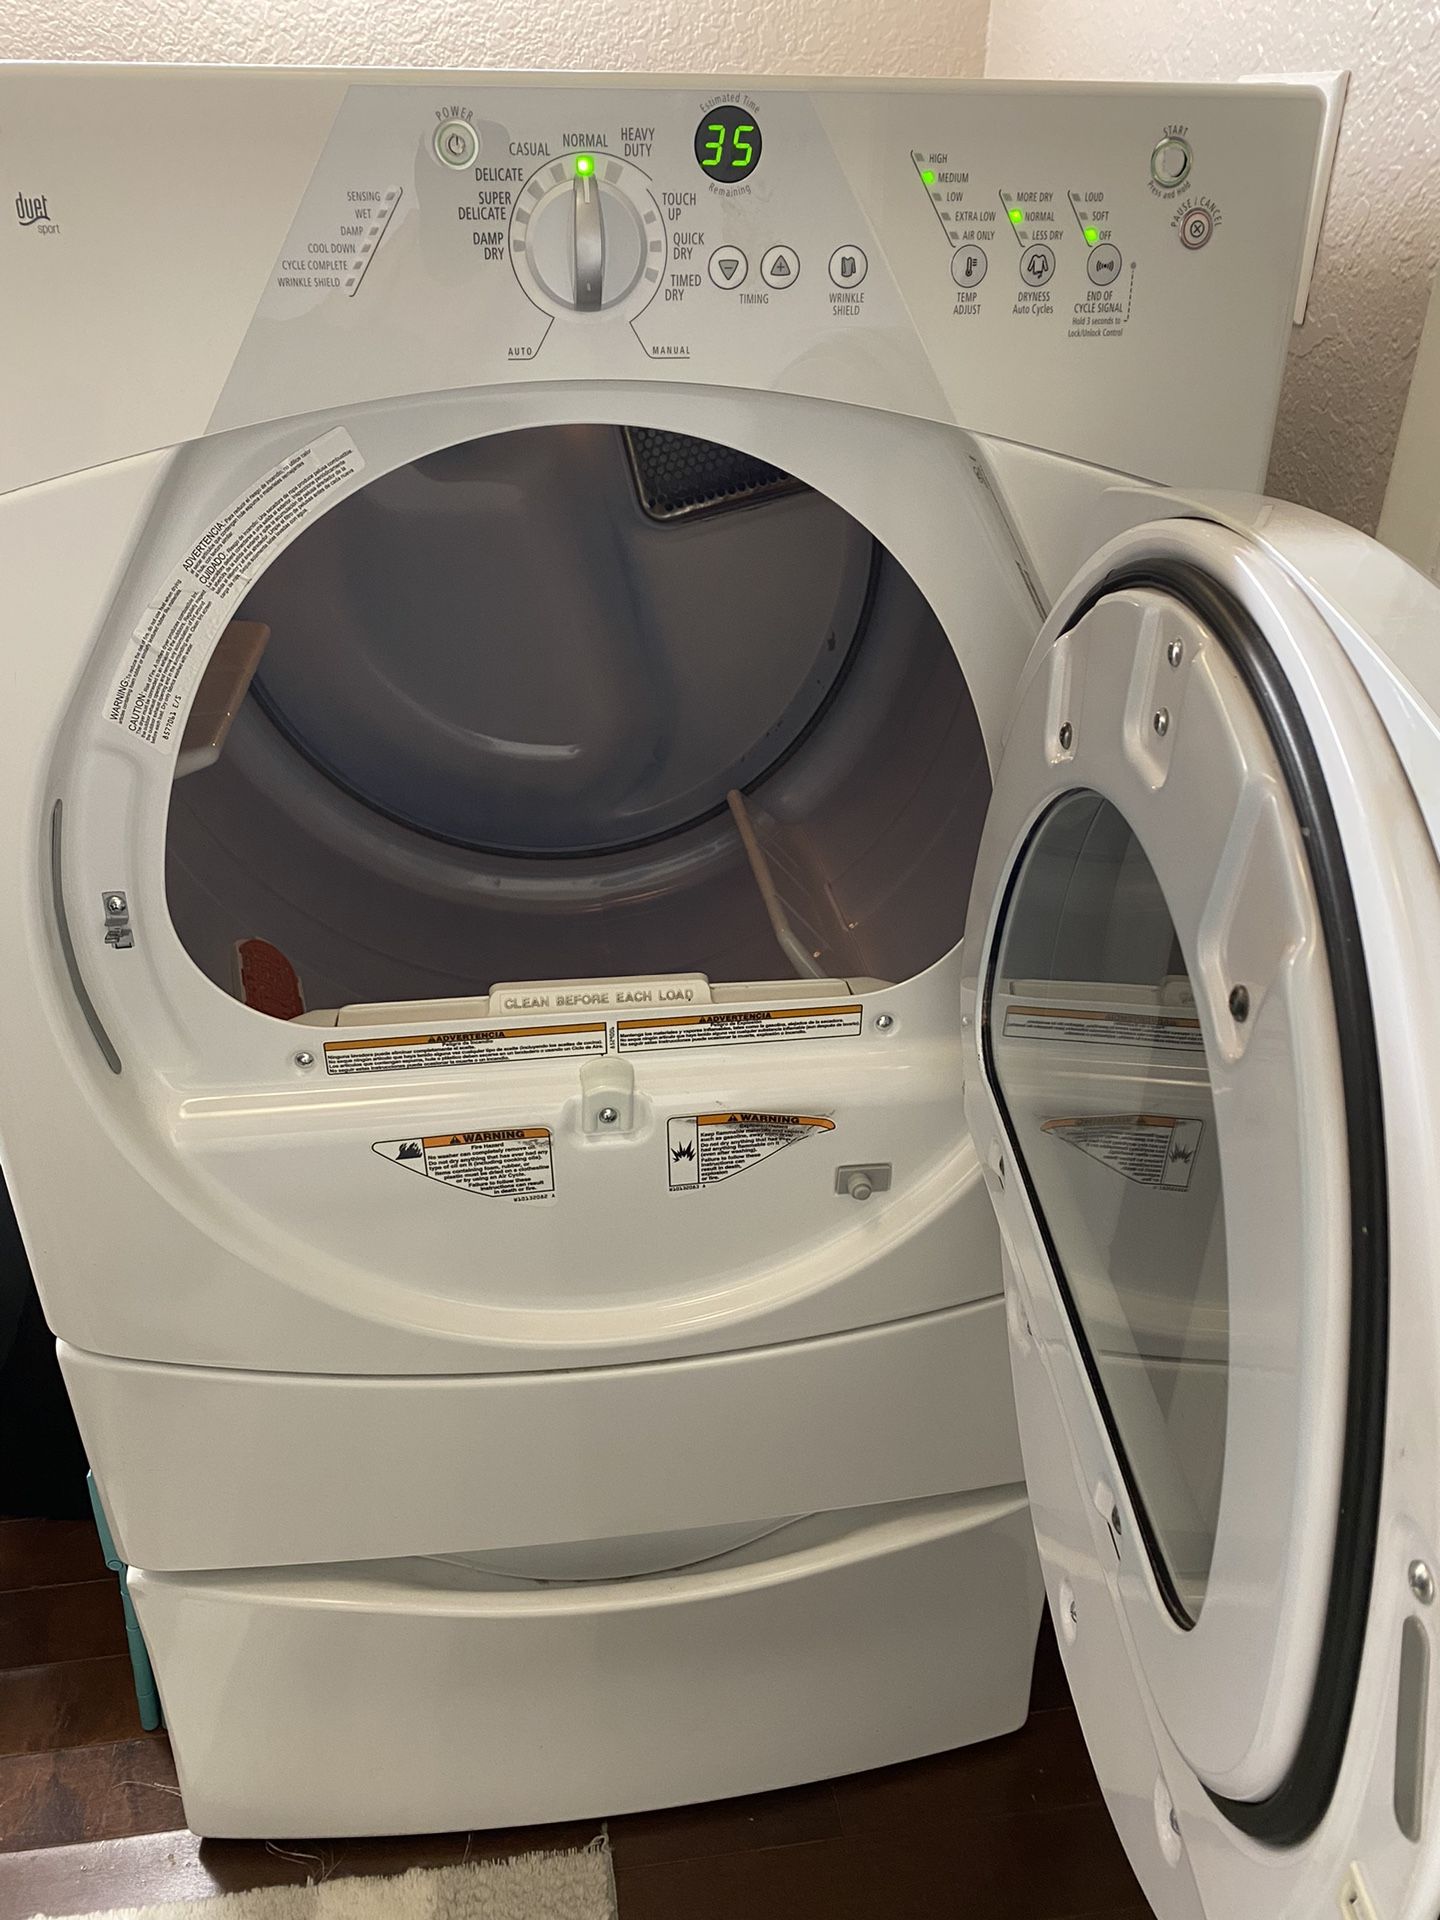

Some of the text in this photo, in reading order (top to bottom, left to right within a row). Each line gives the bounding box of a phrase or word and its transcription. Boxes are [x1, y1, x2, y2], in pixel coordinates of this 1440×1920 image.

[699, 93, 760, 114] Estimated Time
[436, 105, 474, 121] POWER
[620, 127, 655, 141] HEAVY
[1163, 125, 1188, 137] START
[562, 133, 608, 148] NORMAL
[702, 124, 754, 166] 35
[509, 142, 551, 156] CASUAL
[624, 143, 653, 157] DUTY
[929, 153, 948, 164] HIGH
[475, 168, 523, 181] DELICATE
[938, 172, 969, 183] MEDIUM
[708, 182, 752, 197] Remaining
[347, 191, 381, 201] SENSING
[479, 191, 511, 204] SUPER
[662, 192, 697, 206] TOUCH
[946, 192, 963, 202] LOW
[1017, 192, 1054, 202] MORE DRY
[1084, 192, 1104, 202] LOUD
[15, 191, 49, 221] duet
[1171, 198, 1192, 227] PAUSE
[1200, 196, 1222, 227] CANCEL
[355, 209, 371, 219] WET
[458, 207, 507, 220] DELICATE
[668, 208, 682, 221] UP
[955, 211, 996, 221] EXTRA LOW
[1024, 211, 1055, 222] NORMAL
[1092, 211, 1109, 222] SOFT
[37, 224, 61, 235] sport
[341, 226, 363, 236] DAMP
[962, 230, 995, 241] AIR ONLY
[1032, 231, 1063, 240] LESS DRY
[1099, 230, 1112, 240] OFF
[473, 232, 504, 245] DAMP
[673, 232, 705, 246] QUICK
[307, 243, 356, 253] COOL DOWN
[484, 247, 505, 260] DRY
[673, 247, 693, 260] DRY
[282, 260, 348, 270] CYCLE COMPLETE
[277, 277, 340, 287] WRINKLE SHIELD
[671, 274, 702, 287] TIMED
[665, 288, 684, 301] DRY
[739, 293, 769, 304] TIMING
[829, 292, 865, 304] WRINKLE
[957, 292, 977, 303] TEMP
[1018, 292, 1050, 302] DRYNESS
[1087, 290, 1113, 301] END OF
[832, 305, 860, 316] SHIELD
[953, 304, 981, 315] ADJUST
[1012, 304, 1054, 316] Auto Cycles
[1074, 302, 1122, 313] CYCLE SIGNAL
[508, 347, 533, 356] AUTO
[652, 346, 690, 355] MANUAL
[182, 520, 226, 571] ADVERTENCIA:
[110, 678, 129, 720] WARNING:
[128, 692, 147, 731] CAUTION:
[504, 988, 694, 1009] CLEAN BEFORE EACH LOAD
[707, 1012, 772, 1023] ADVERTENCIA
[436, 1031, 505, 1042] ADVERTENCIA
[740, 1113, 800, 1125] WARNING
[463, 1130, 525, 1143] WARNING
